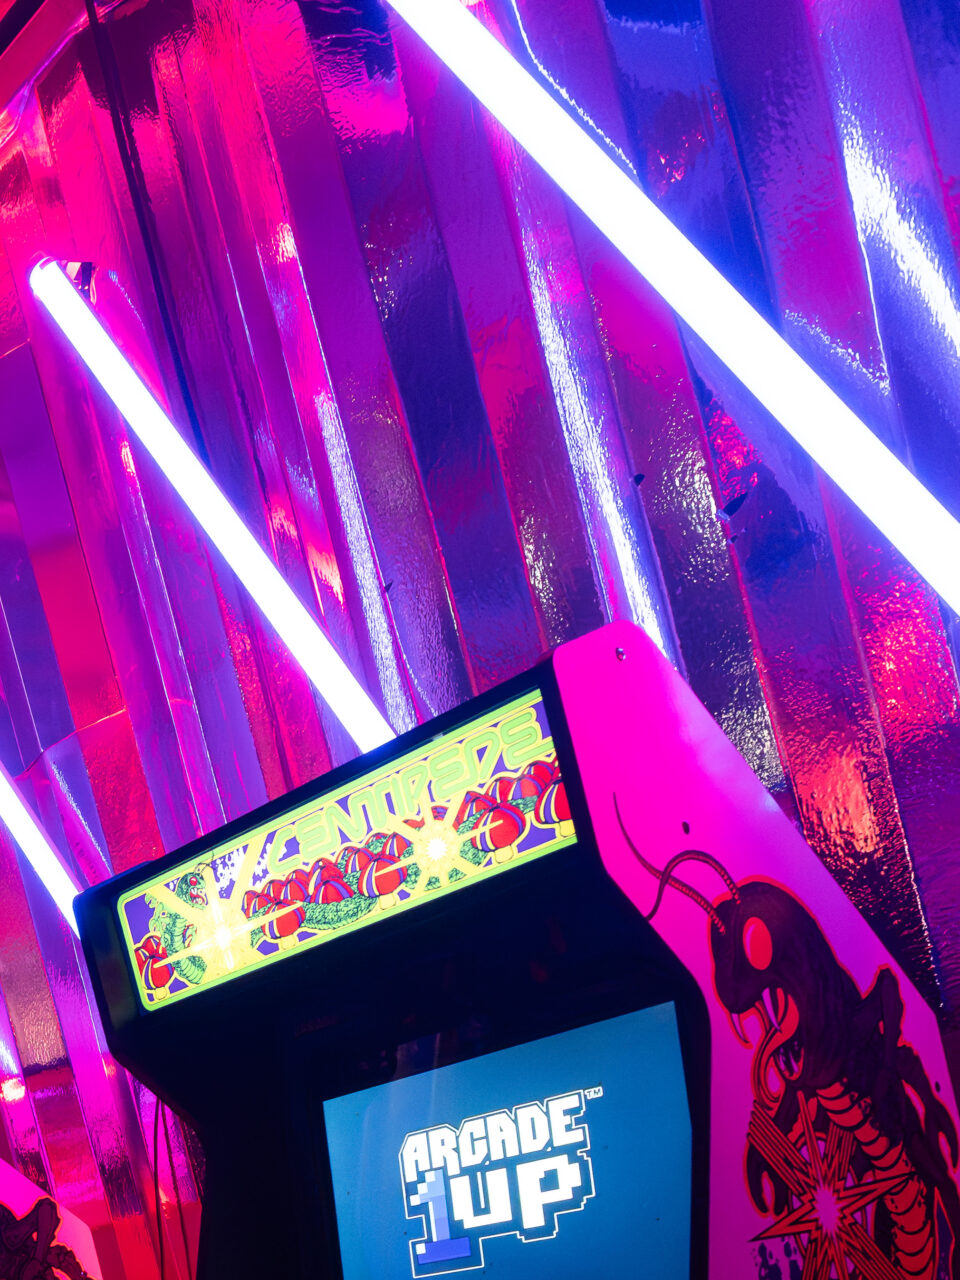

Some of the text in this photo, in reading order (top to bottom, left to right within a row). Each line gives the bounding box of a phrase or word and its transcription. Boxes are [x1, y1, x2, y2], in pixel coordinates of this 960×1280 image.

[268, 709, 540, 873] CENTIPEDE
[401, 1094, 585, 1183] ARCADE
[409, 1154, 582, 1265] 1UP
